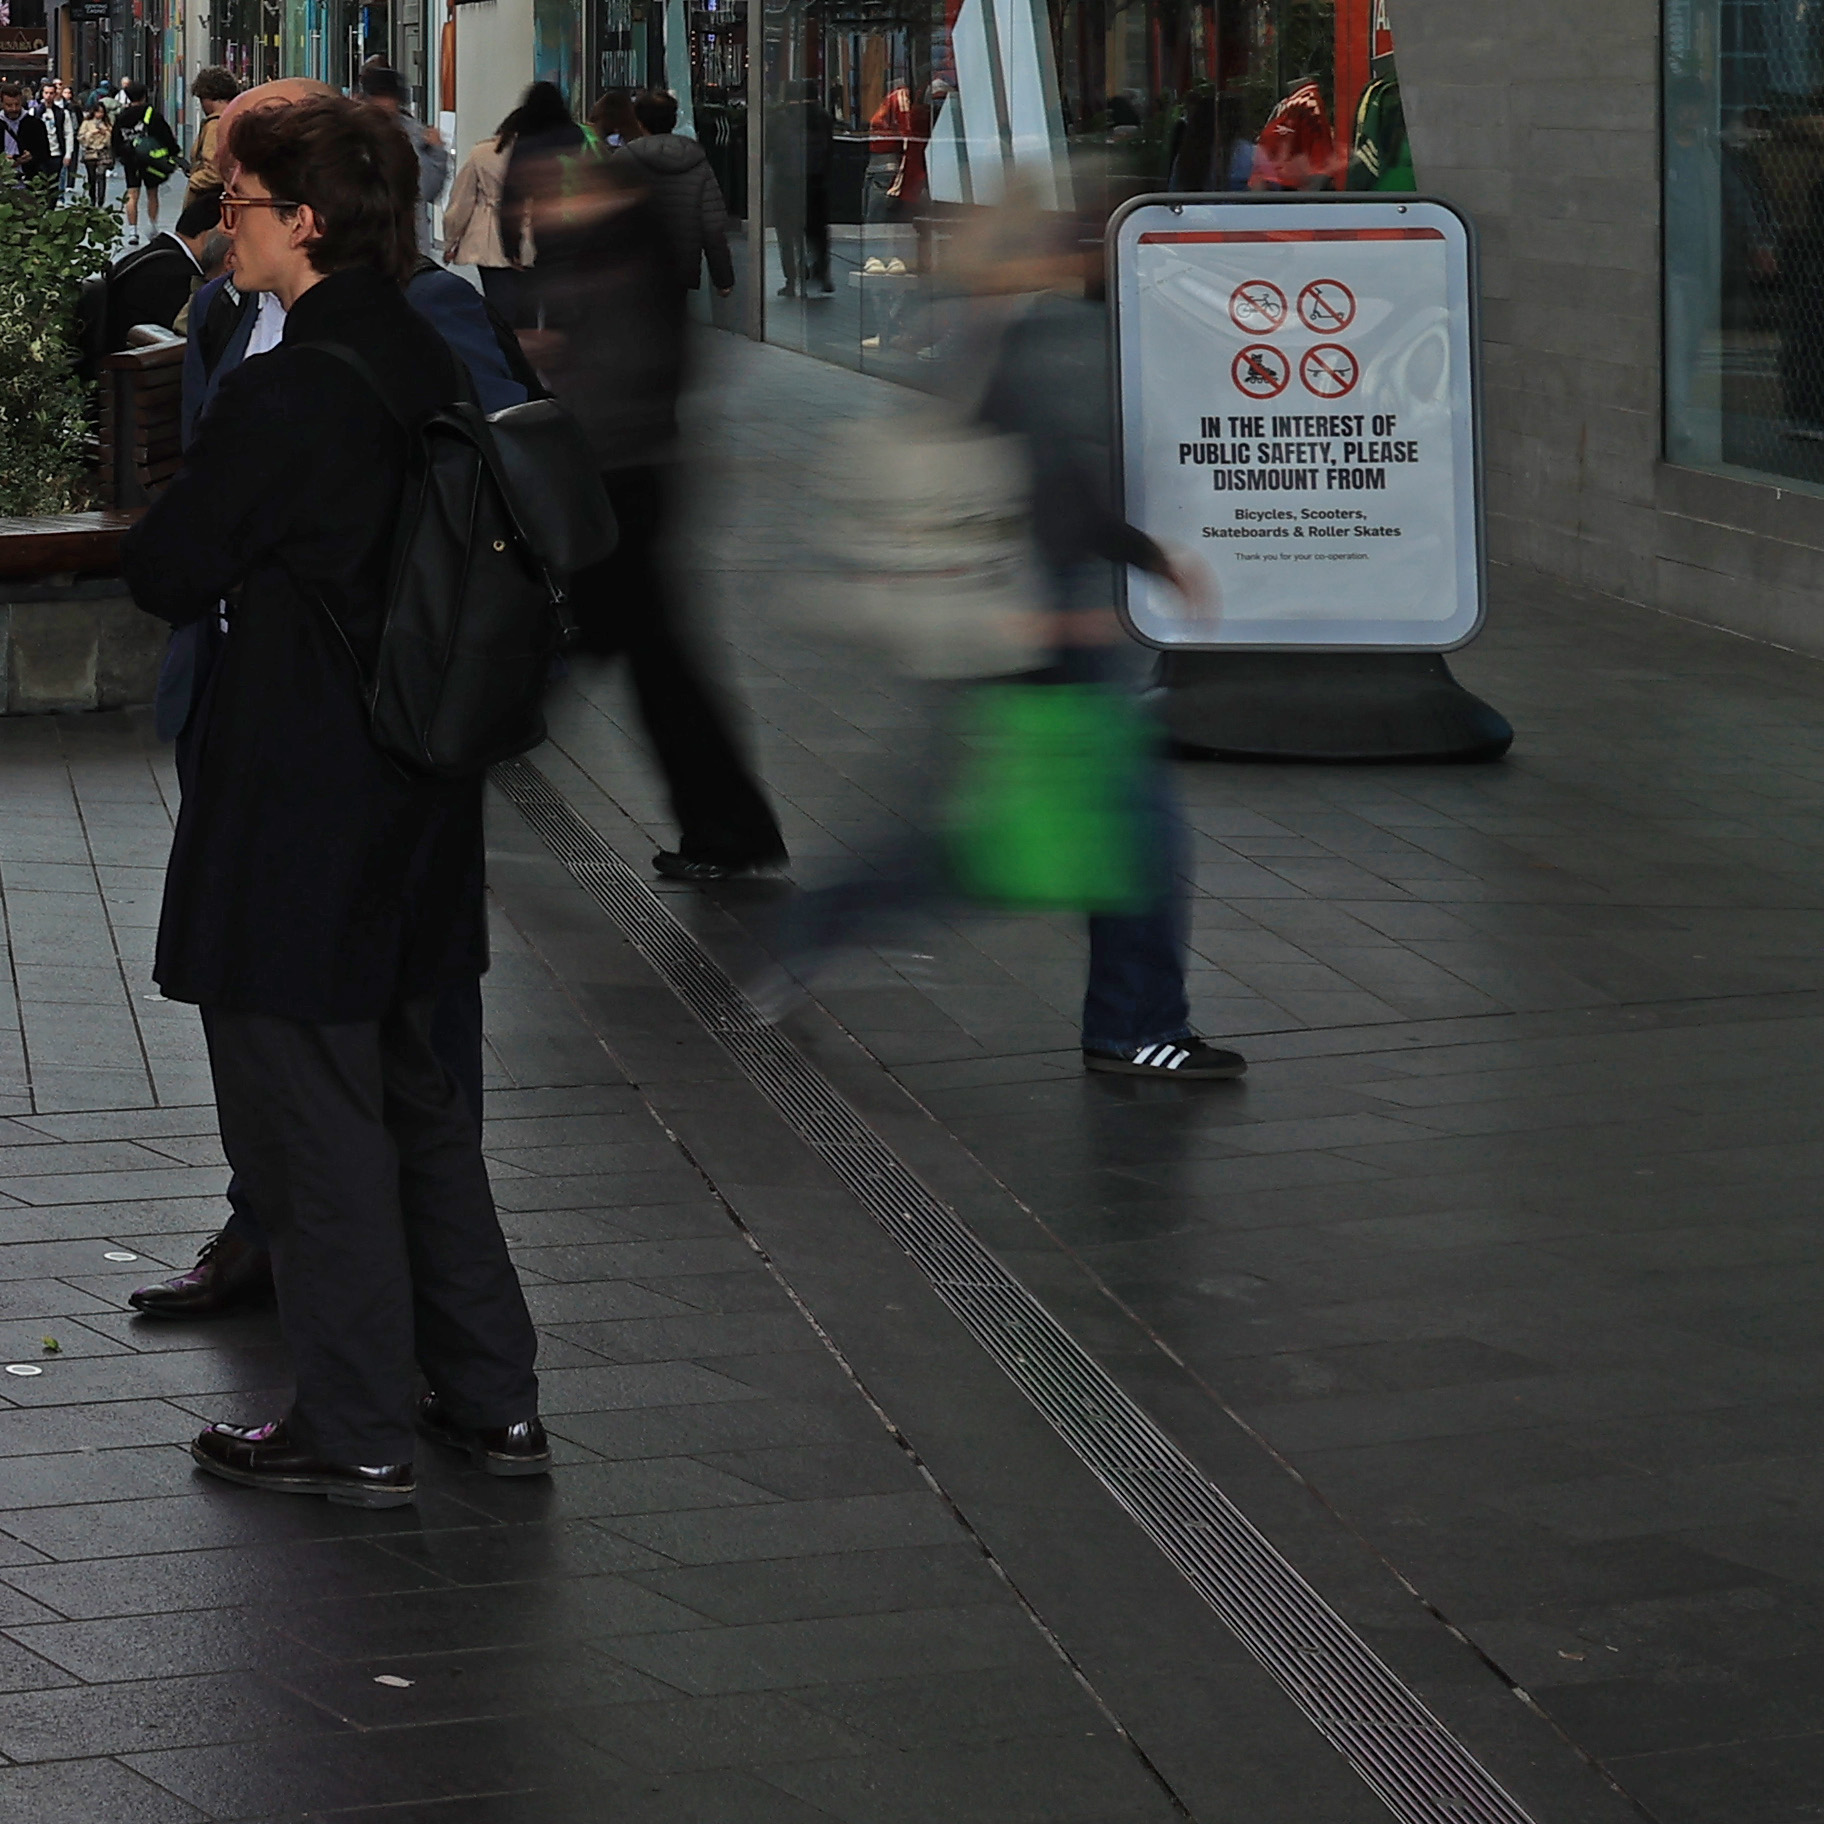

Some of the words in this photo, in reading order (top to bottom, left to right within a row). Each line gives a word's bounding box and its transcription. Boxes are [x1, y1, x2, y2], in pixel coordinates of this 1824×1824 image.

[1200, 416, 1221, 439] IN
[1227, 415, 1266, 439] THE
[1271, 414, 1365, 438] INTEREST
[1371, 414, 1397, 437] OF
[1179, 442, 1251, 465] PUBLIC
[1257, 441, 1337, 467] SAFETY,
[1343, 440, 1419, 463] PLEASE
[1213, 468, 1319, 491] DISMOUNT
[1326, 467, 1386, 490] FROM
[1234, 508, 1298, 523] Bicycles,
[1300, 507, 1368, 522] Scooters,
[1202, 526, 1289, 538] Skateboards
[1292, 526, 1305, 538] &
[1308, 525, 1350, 537] Roller
[1354, 525, 1402, 537] Skates
[1234, 552, 1260, 561] Thank
[1263, 554, 1278, 562] you
[1279, 552, 1292, 560] for
[1294, 554, 1312, 562] your
